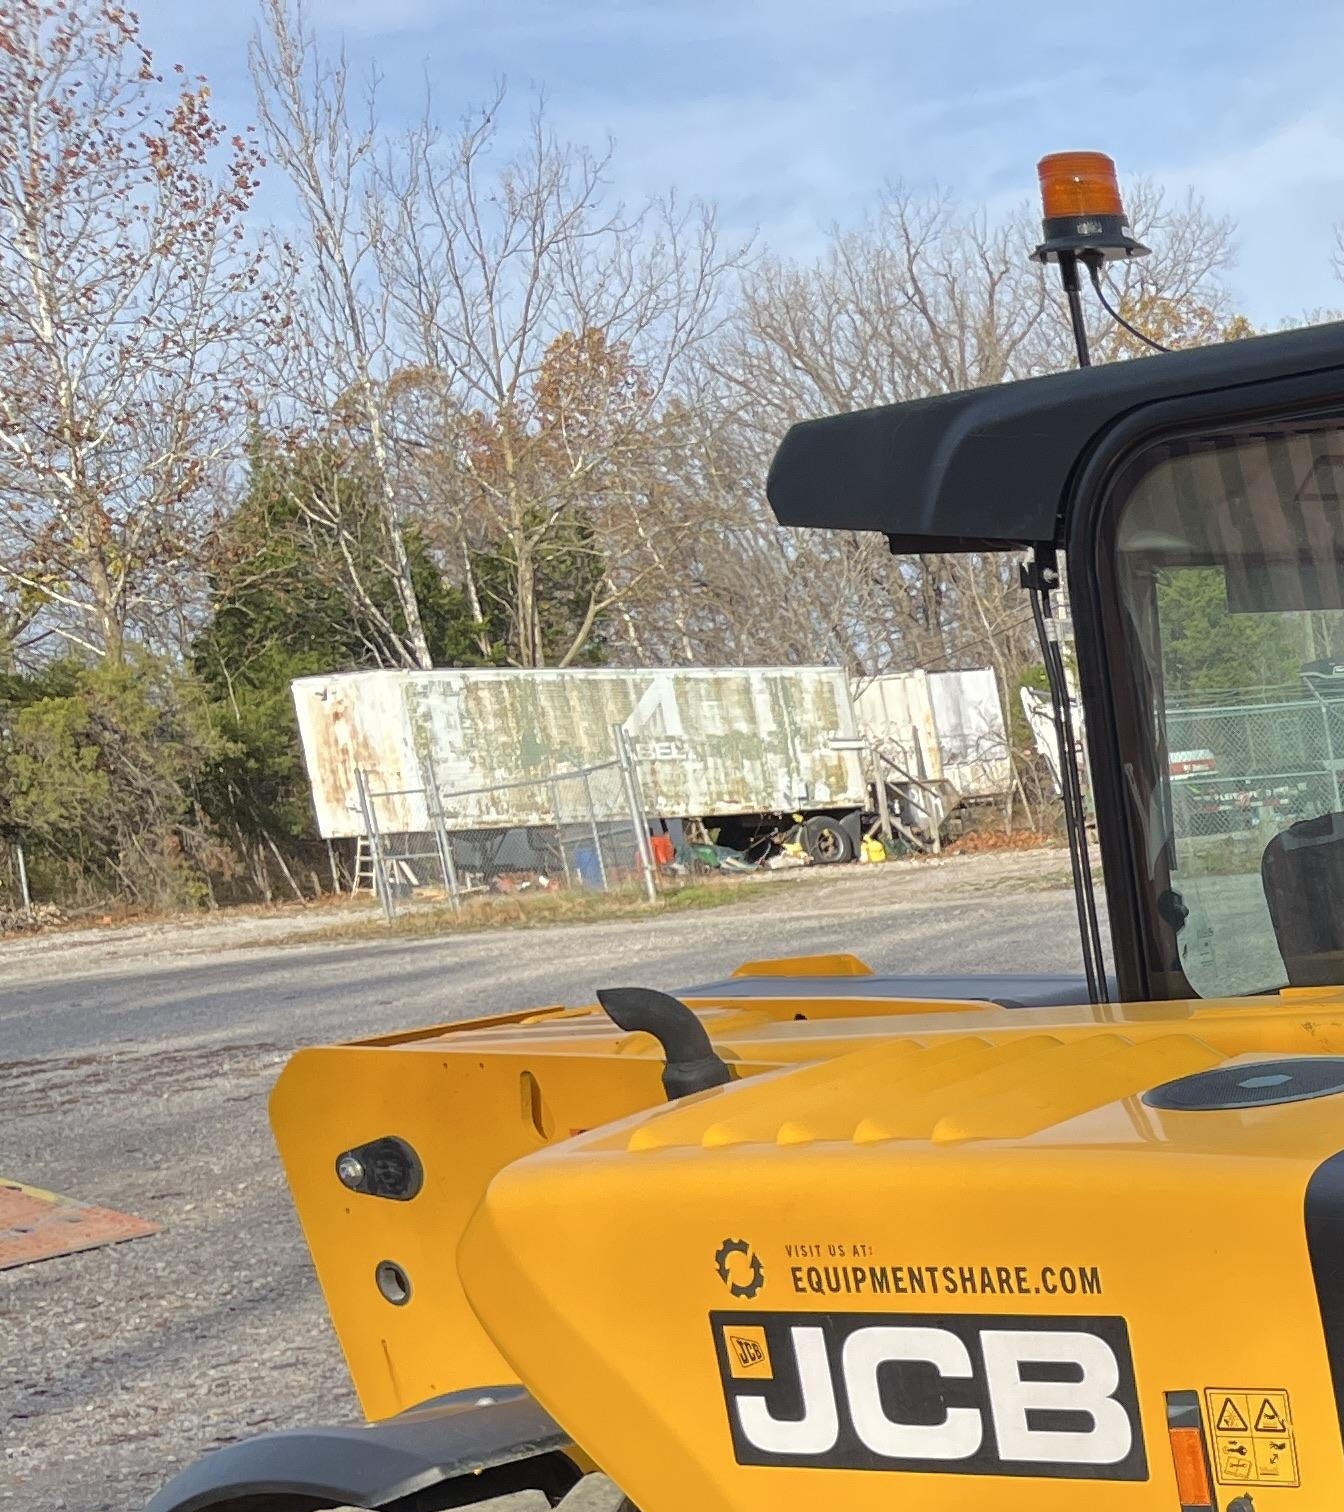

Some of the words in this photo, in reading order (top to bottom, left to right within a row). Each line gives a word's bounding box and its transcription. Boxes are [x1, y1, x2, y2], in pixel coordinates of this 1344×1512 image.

[785, 1244, 822, 1258] VISIT
[828, 1244, 846, 1258] US
[852, 1244, 873, 1258] AT:
[790, 1265, 1103, 1297] EQUIPMENTSHARE.COM
[737, 1338, 764, 1364] JCB
[736, 1325, 1133, 1465] JCB
